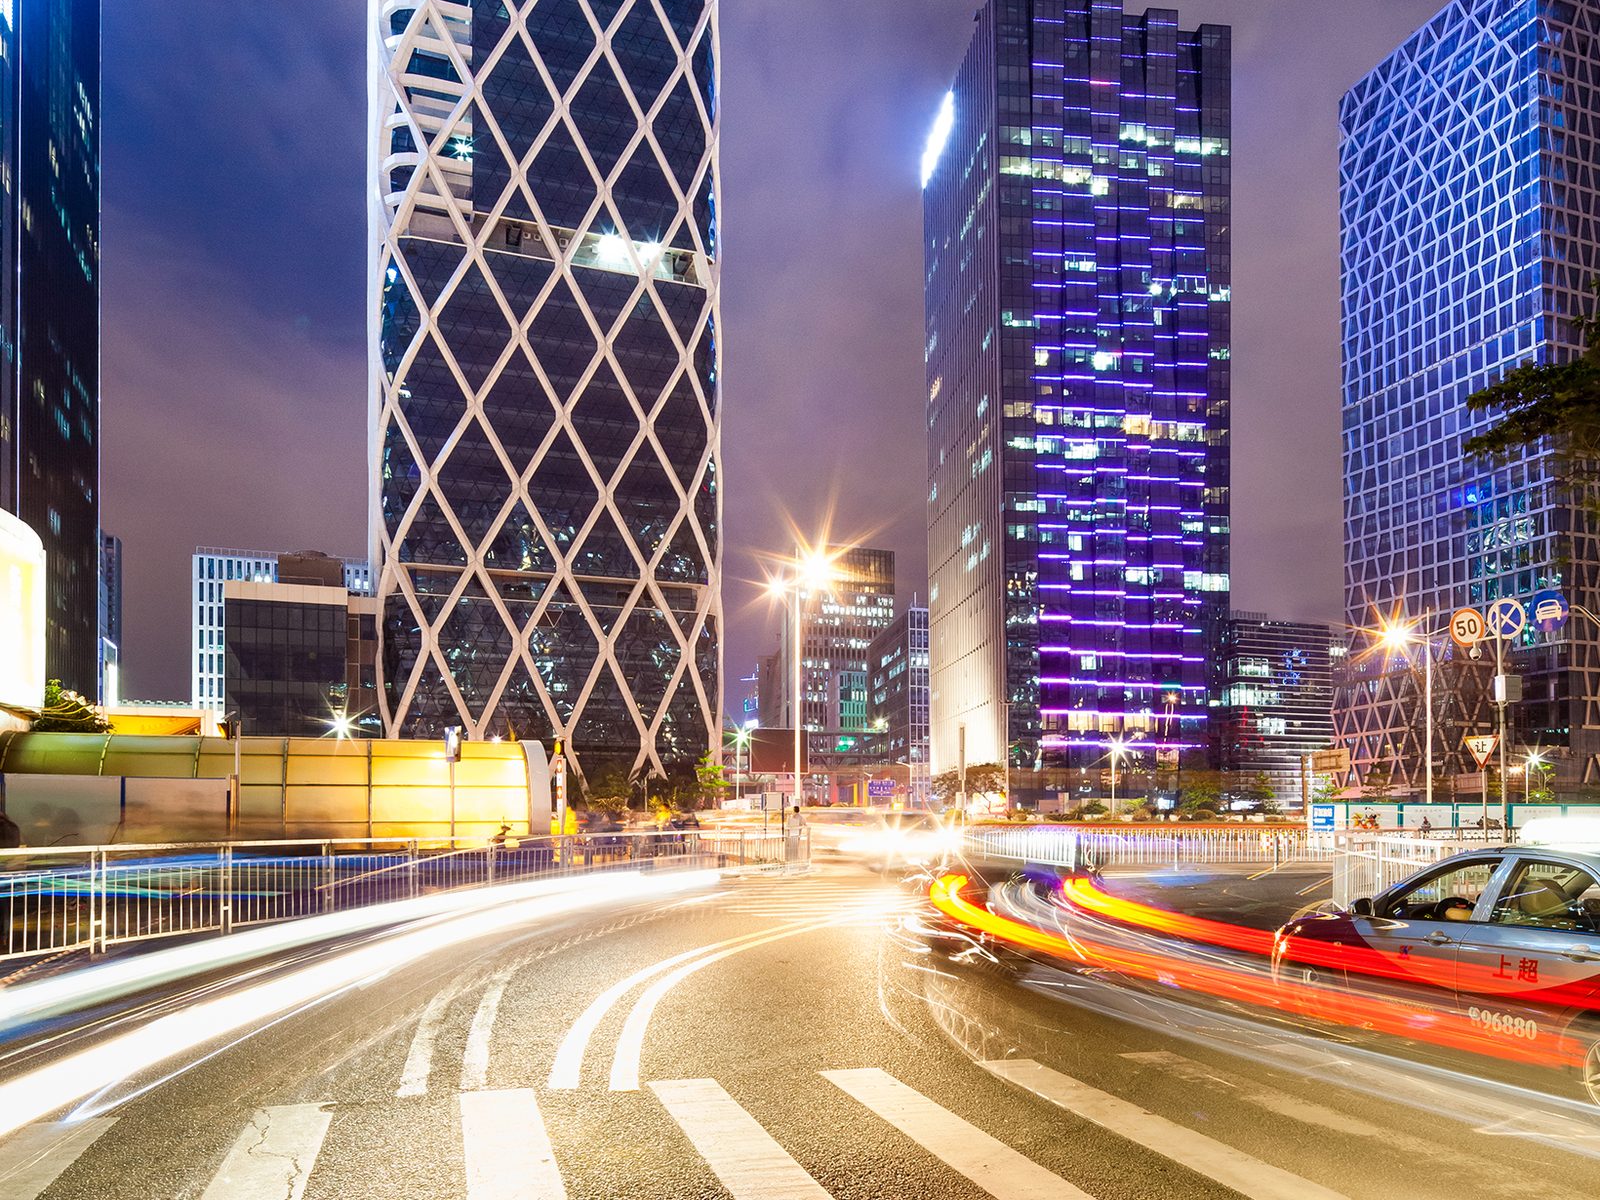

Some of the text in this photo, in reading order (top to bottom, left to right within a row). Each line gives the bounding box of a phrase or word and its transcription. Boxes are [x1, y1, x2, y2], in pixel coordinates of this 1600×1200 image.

[1455, 618, 1478, 637] 50
[1475, 741, 1488, 754] 让
[1492, 954, 1539, 983] 上超
[1480, 1009, 1538, 1040] 96880
